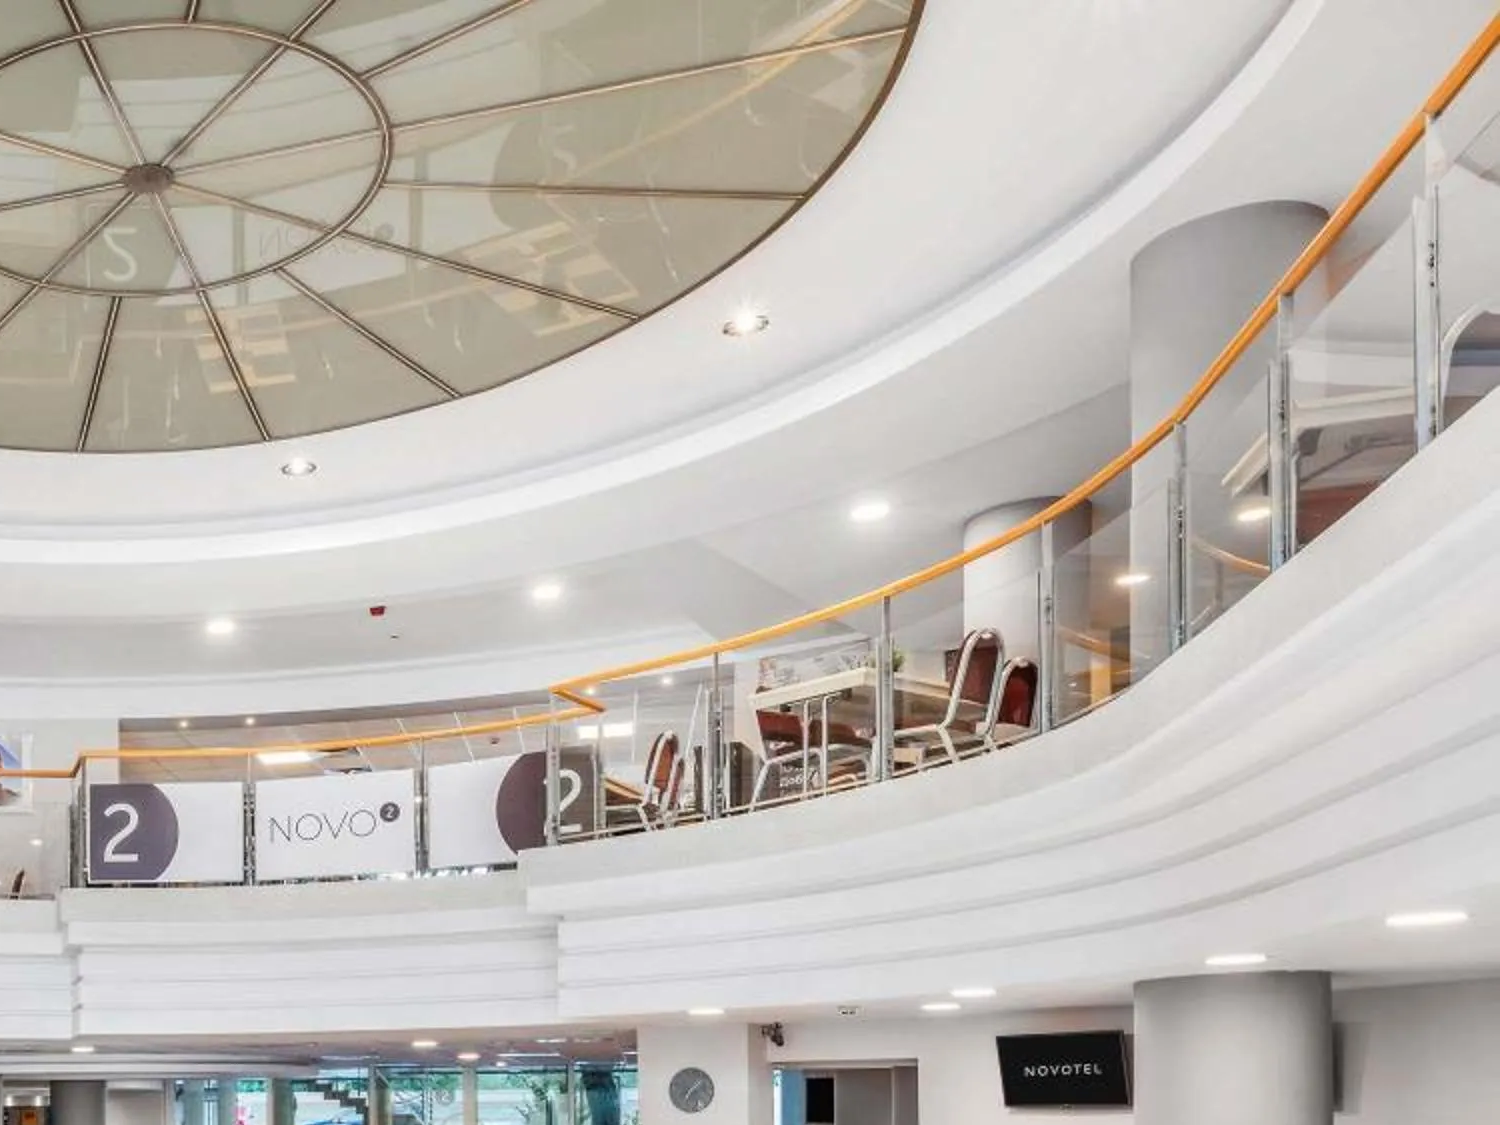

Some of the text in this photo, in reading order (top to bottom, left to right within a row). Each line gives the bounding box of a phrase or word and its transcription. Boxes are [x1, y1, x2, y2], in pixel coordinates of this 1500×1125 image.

[543, 768, 582, 836] 2
[103, 803, 139, 863] 2
[269, 810, 377, 843] NOVO
[1023, 1063, 1102, 1077] NOVOTEL
